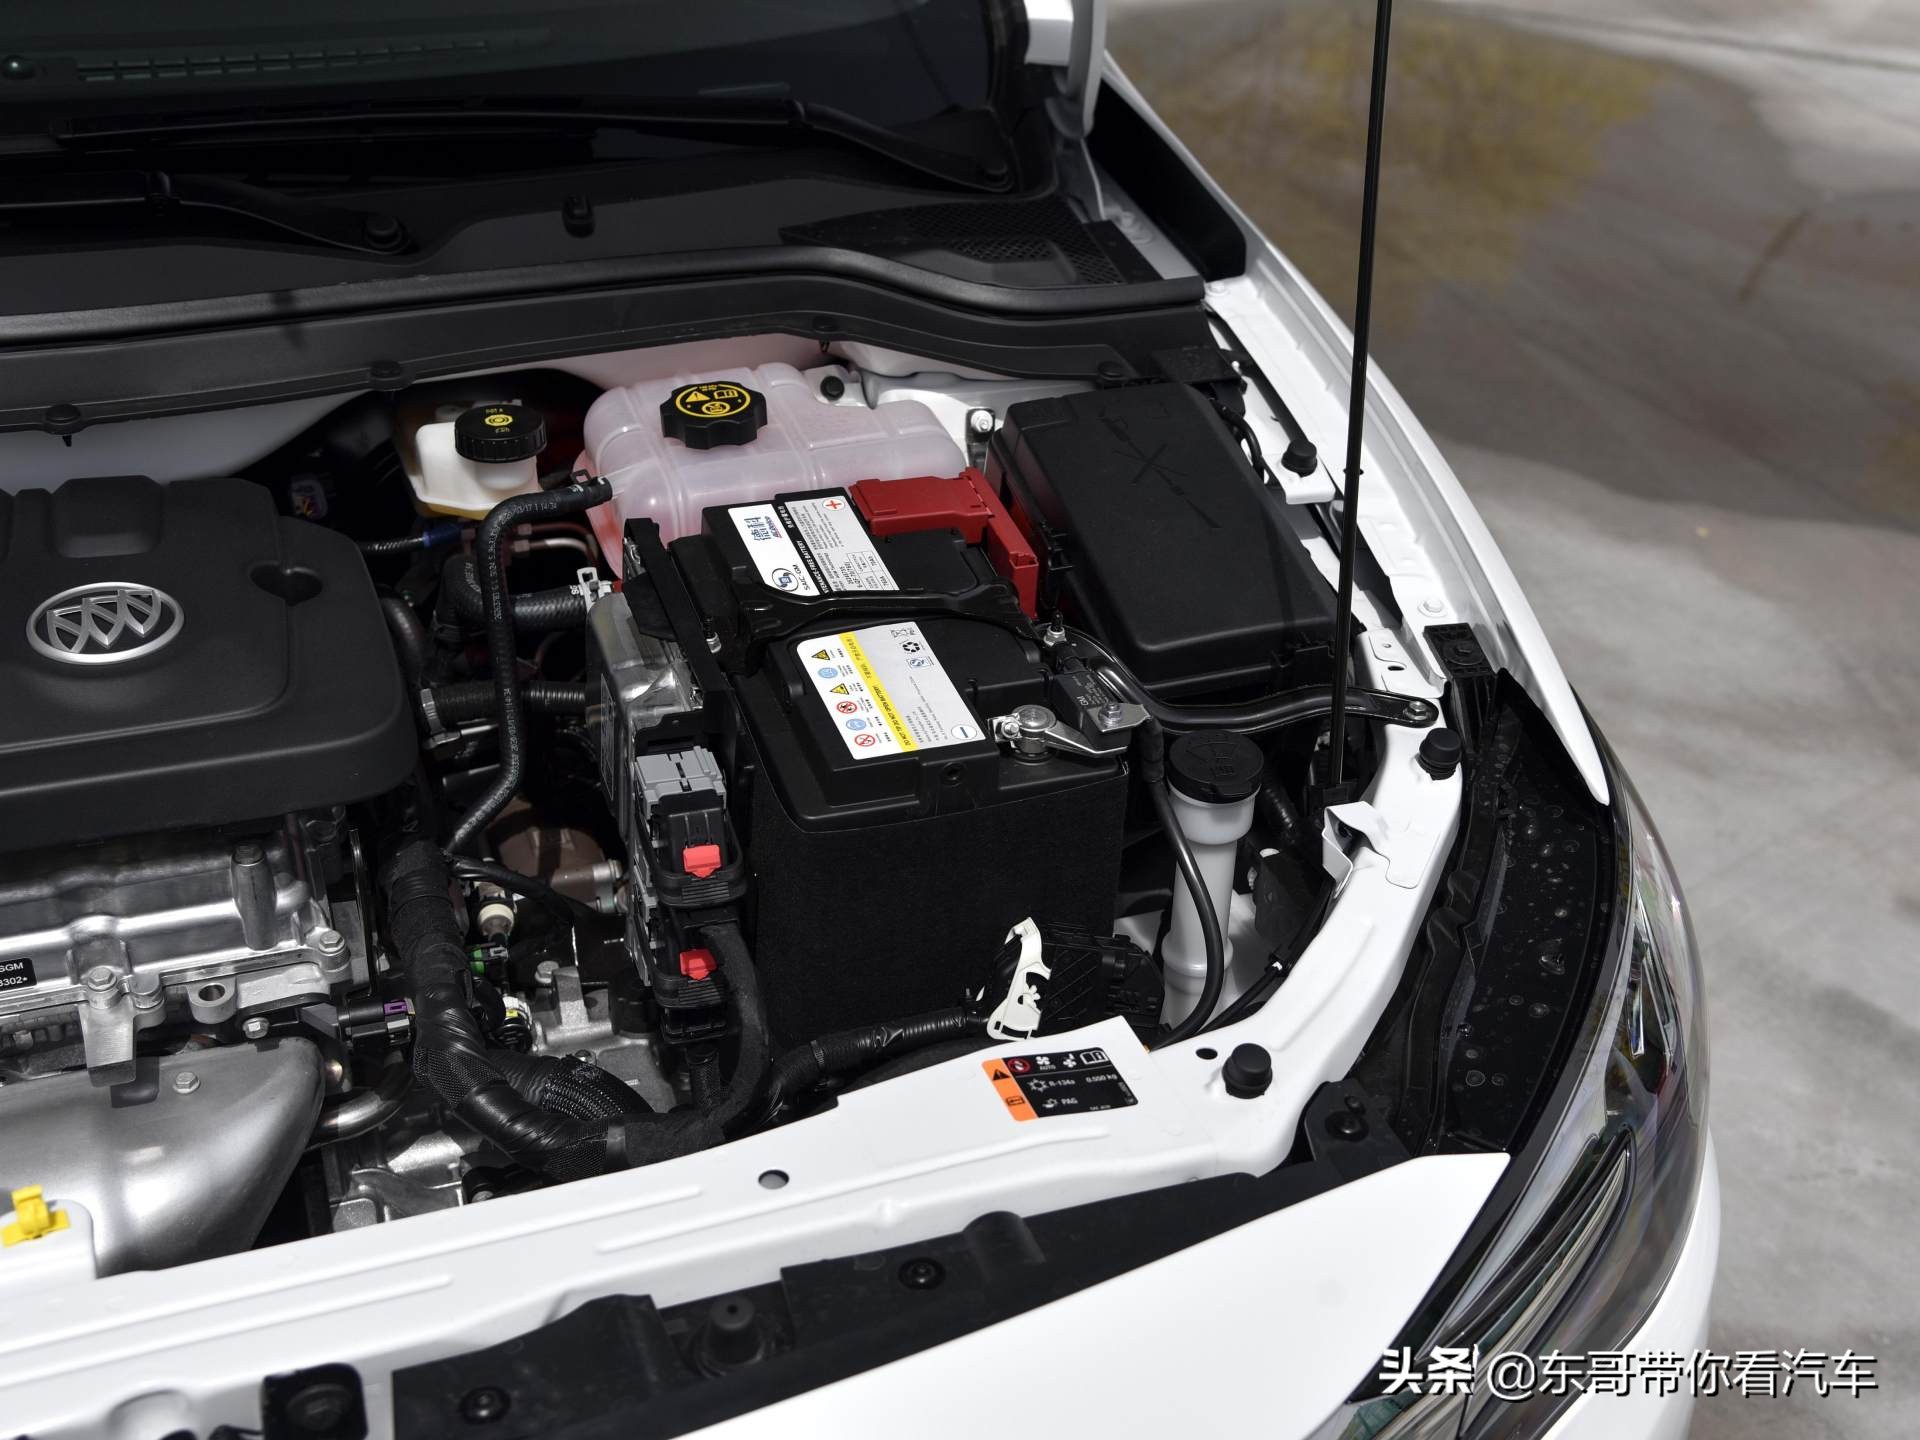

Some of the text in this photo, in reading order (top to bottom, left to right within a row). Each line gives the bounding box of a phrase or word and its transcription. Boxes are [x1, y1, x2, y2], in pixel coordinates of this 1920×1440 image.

[796, 540, 811, 559] BATTERY
[792, 564, 810, 590] SAIC-GM
[1076, 695, 1089, 706] GM
[1061, 1097, 1079, 1105] PAG
